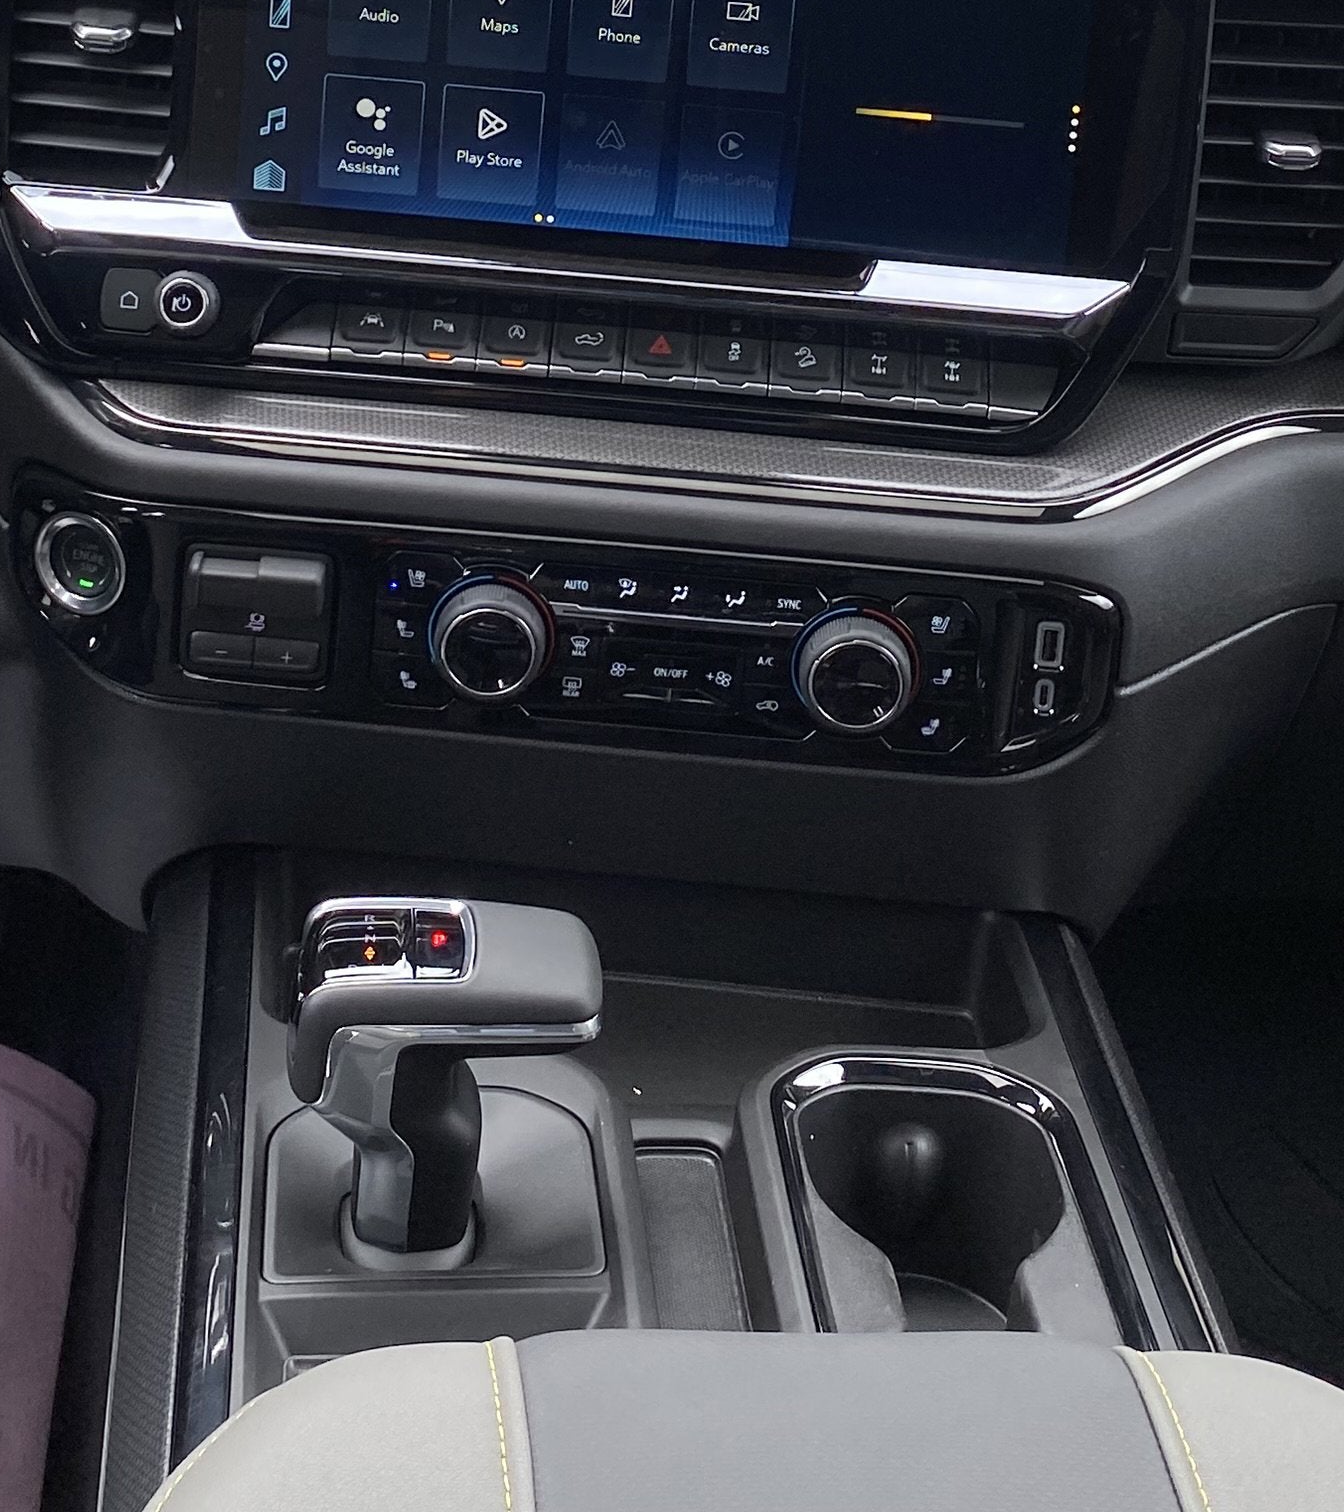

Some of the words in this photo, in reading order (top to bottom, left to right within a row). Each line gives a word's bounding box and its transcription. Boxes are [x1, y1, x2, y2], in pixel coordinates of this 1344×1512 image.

[359, 7, 400, 24] Audio
[480, 18, 519, 35] Maps
[598, 28, 641, 44] Phone
[709, 37, 770, 55] Cameras
[345, 140, 395, 159] Google
[456, 150, 485, 168] Play
[487, 153, 523, 168] Store
[337, 159, 400, 177] Assistant
[621, 164, 652, 178] Auto
[564, 579, 589, 591] AUTO
[777, 599, 802, 610] SYNC
[757, 656, 774, 667] A/C
[654, 668, 688, 679] ON/OFF
